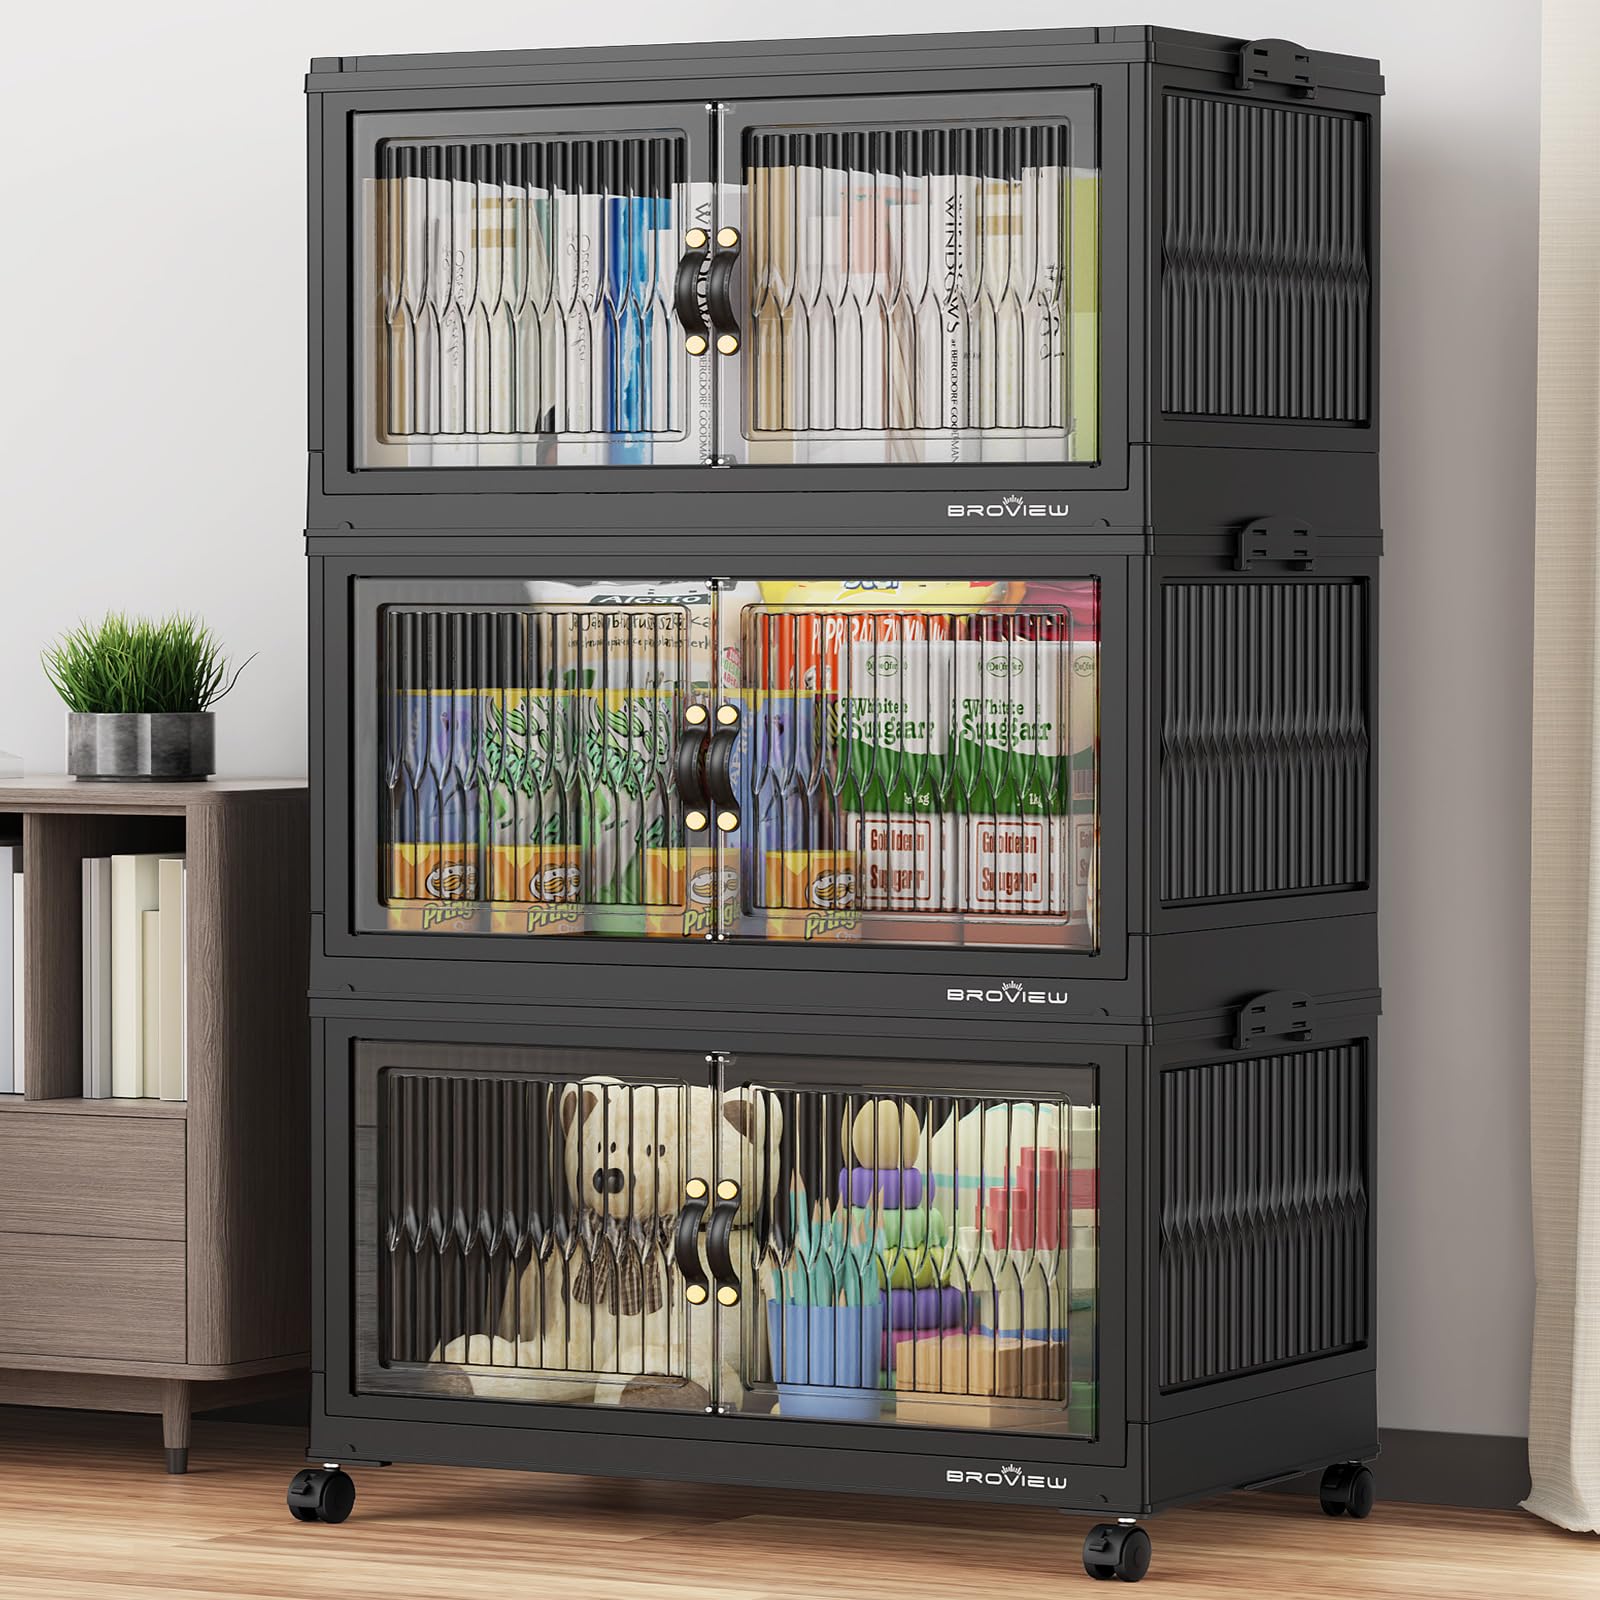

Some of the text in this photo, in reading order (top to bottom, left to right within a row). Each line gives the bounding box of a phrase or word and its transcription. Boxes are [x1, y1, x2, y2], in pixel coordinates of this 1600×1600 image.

[947, 502, 1069, 517] BROVIEW
[599, 594, 702, 605] Alesto
[947, 986, 1068, 1004] BROVIEW
[946, 1468, 1067, 1490] BROVIEW
